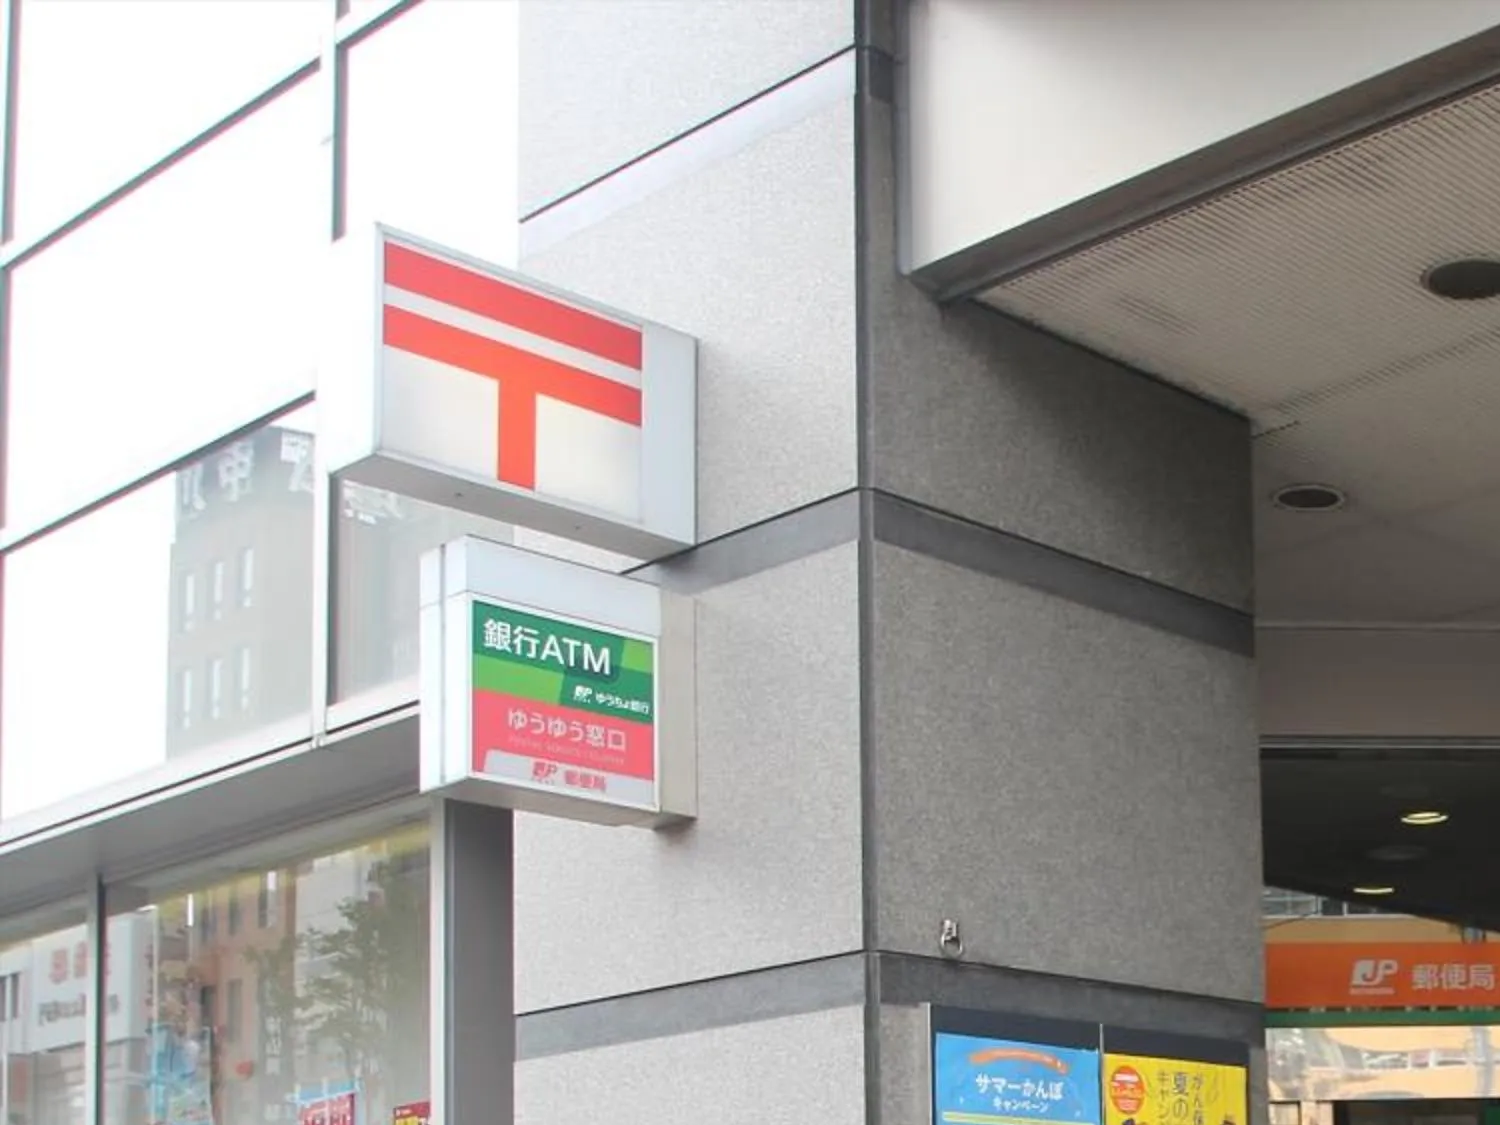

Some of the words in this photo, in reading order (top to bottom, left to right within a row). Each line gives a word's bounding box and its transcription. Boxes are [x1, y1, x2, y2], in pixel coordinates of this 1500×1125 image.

[483, 618, 611, 675] 銀行ATM
[596, 692, 649, 715] ゆうちょ銀行
[508, 708, 626, 751] ゆうゆう窓口
[1411, 964, 1496, 990] 郵便局
